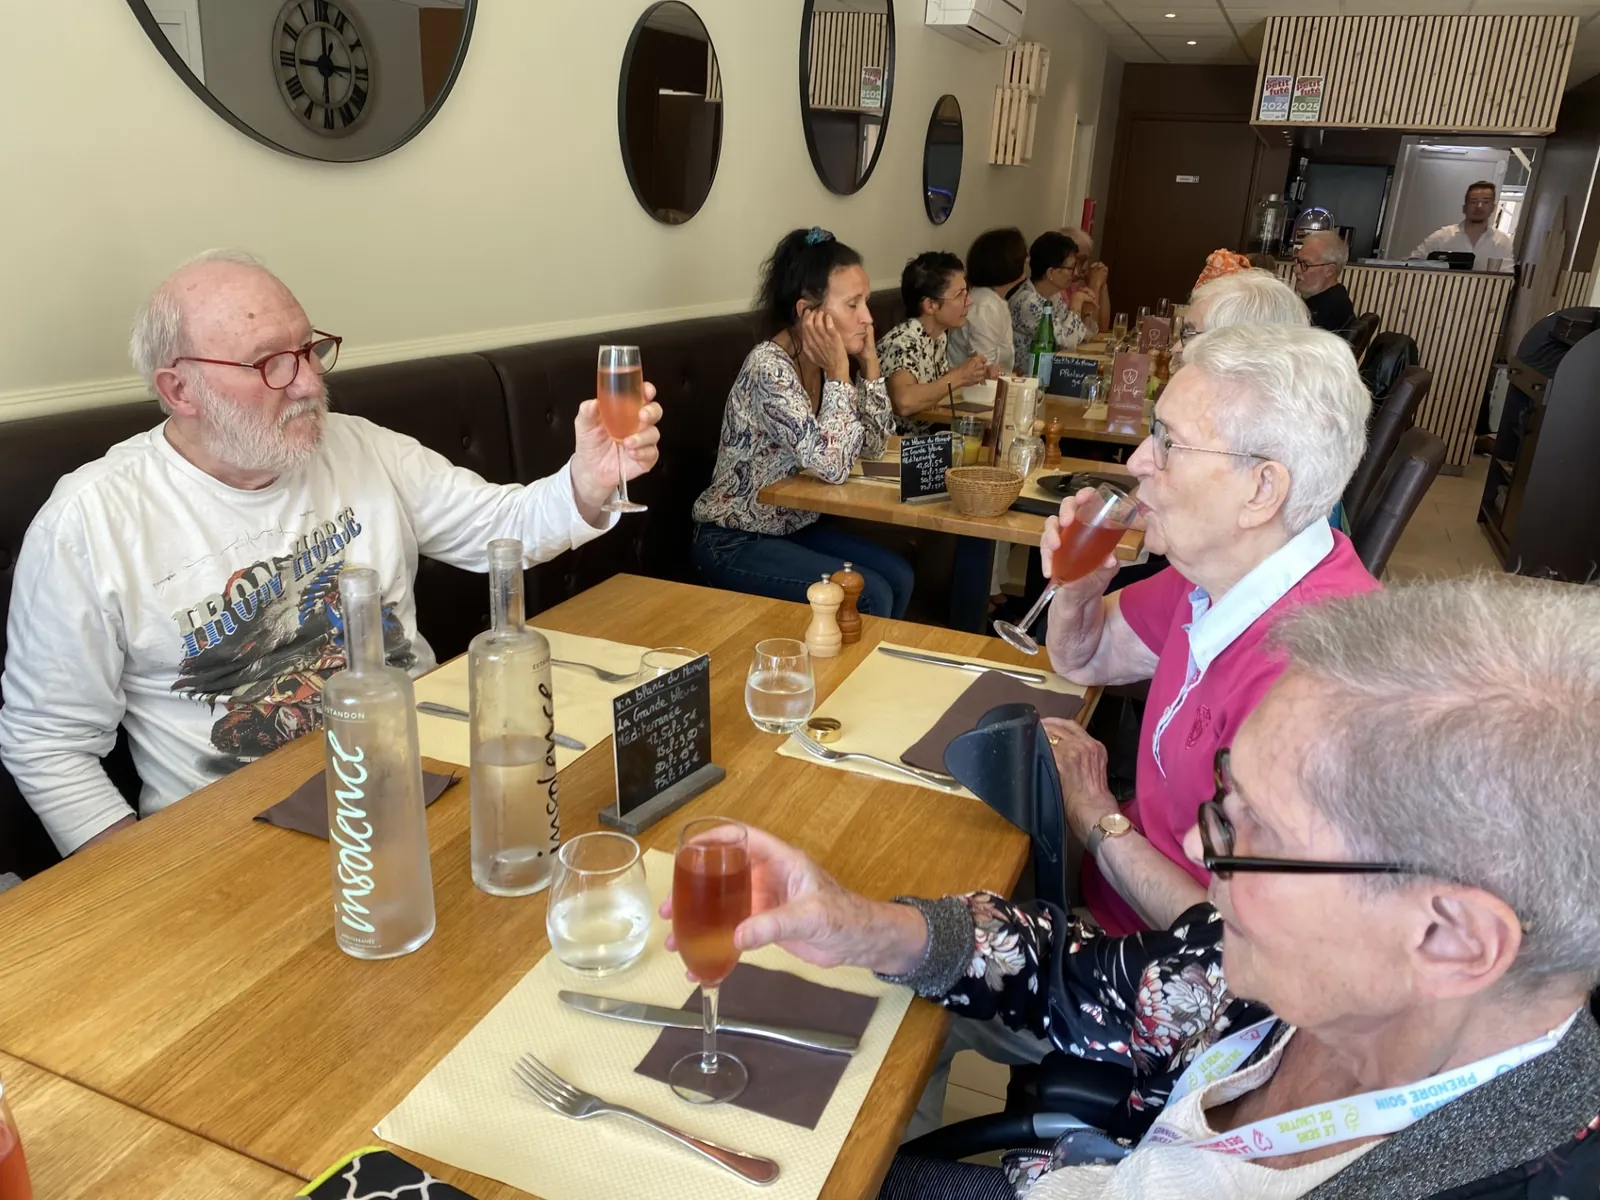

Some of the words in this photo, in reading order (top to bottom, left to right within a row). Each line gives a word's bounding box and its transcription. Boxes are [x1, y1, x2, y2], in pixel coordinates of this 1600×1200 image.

[1266, 79, 1289, 91] petit
[1269, 87, 1289, 96] futé
[1297, 80, 1321, 91] petit
[1301, 87, 1321, 96] futé
[1292, 102, 1319, 111] 2025
[172, 554, 293, 659] IRON
[291, 507, 362, 582] HORSE
[636, 682, 664, 701] blanc
[668, 671, 680, 684] du
[617, 717, 631, 732] La
[633, 695, 668, 722] Grande
[328, 729, 375, 934] insolence
[1409, 1072, 1477, 1103] PRENDRE
[1375, 1094, 1407, 1110] SOIN
[1318, 1109, 1332, 1122] DE
[1323, 1123, 1336, 1136] LE
